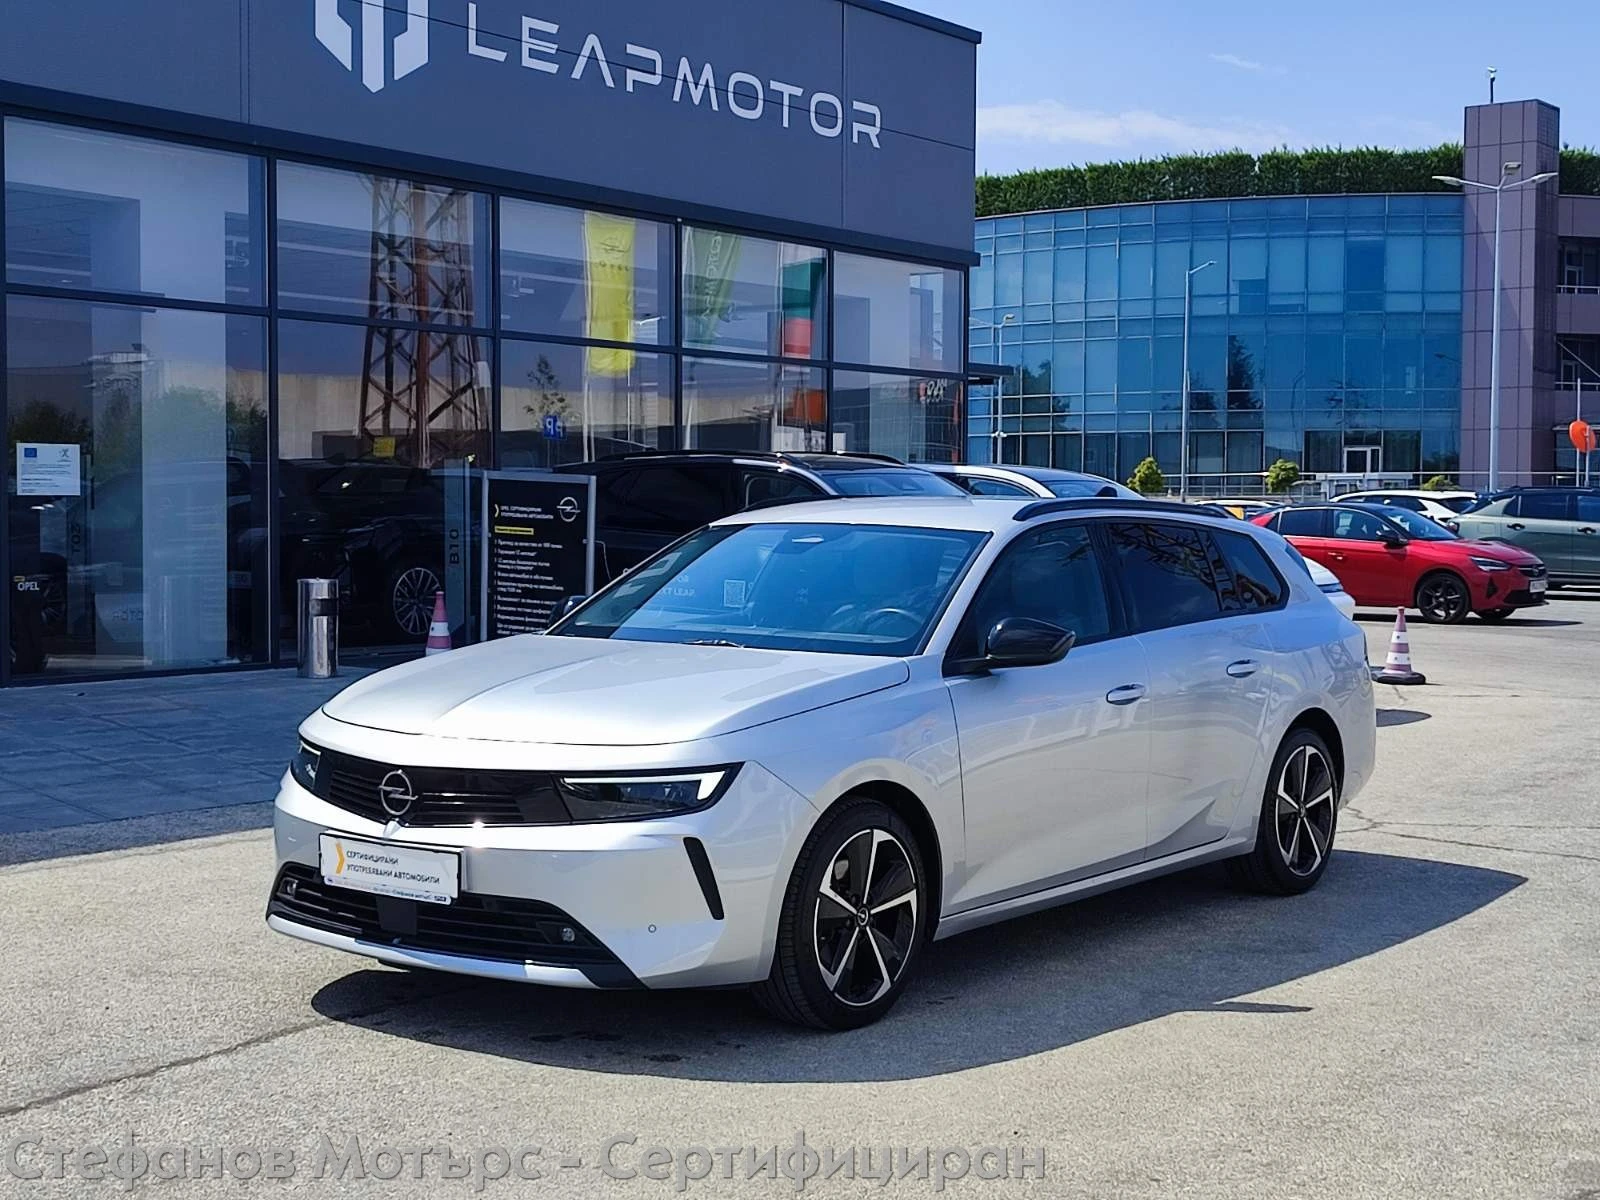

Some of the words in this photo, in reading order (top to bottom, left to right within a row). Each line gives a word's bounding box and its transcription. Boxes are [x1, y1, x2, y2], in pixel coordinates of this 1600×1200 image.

[467, 2, 882, 149] LEAPMOTOR
[449, 528, 460, 565] B10
[17, 582, 40, 592] OPEL
[346, 850, 400, 865] СЕРТИФИЦИРАНИ
[346, 864, 393, 877] УПОТРЕБЯВАНИ
[393, 871, 441, 884] АВТОМОБИЛИ
